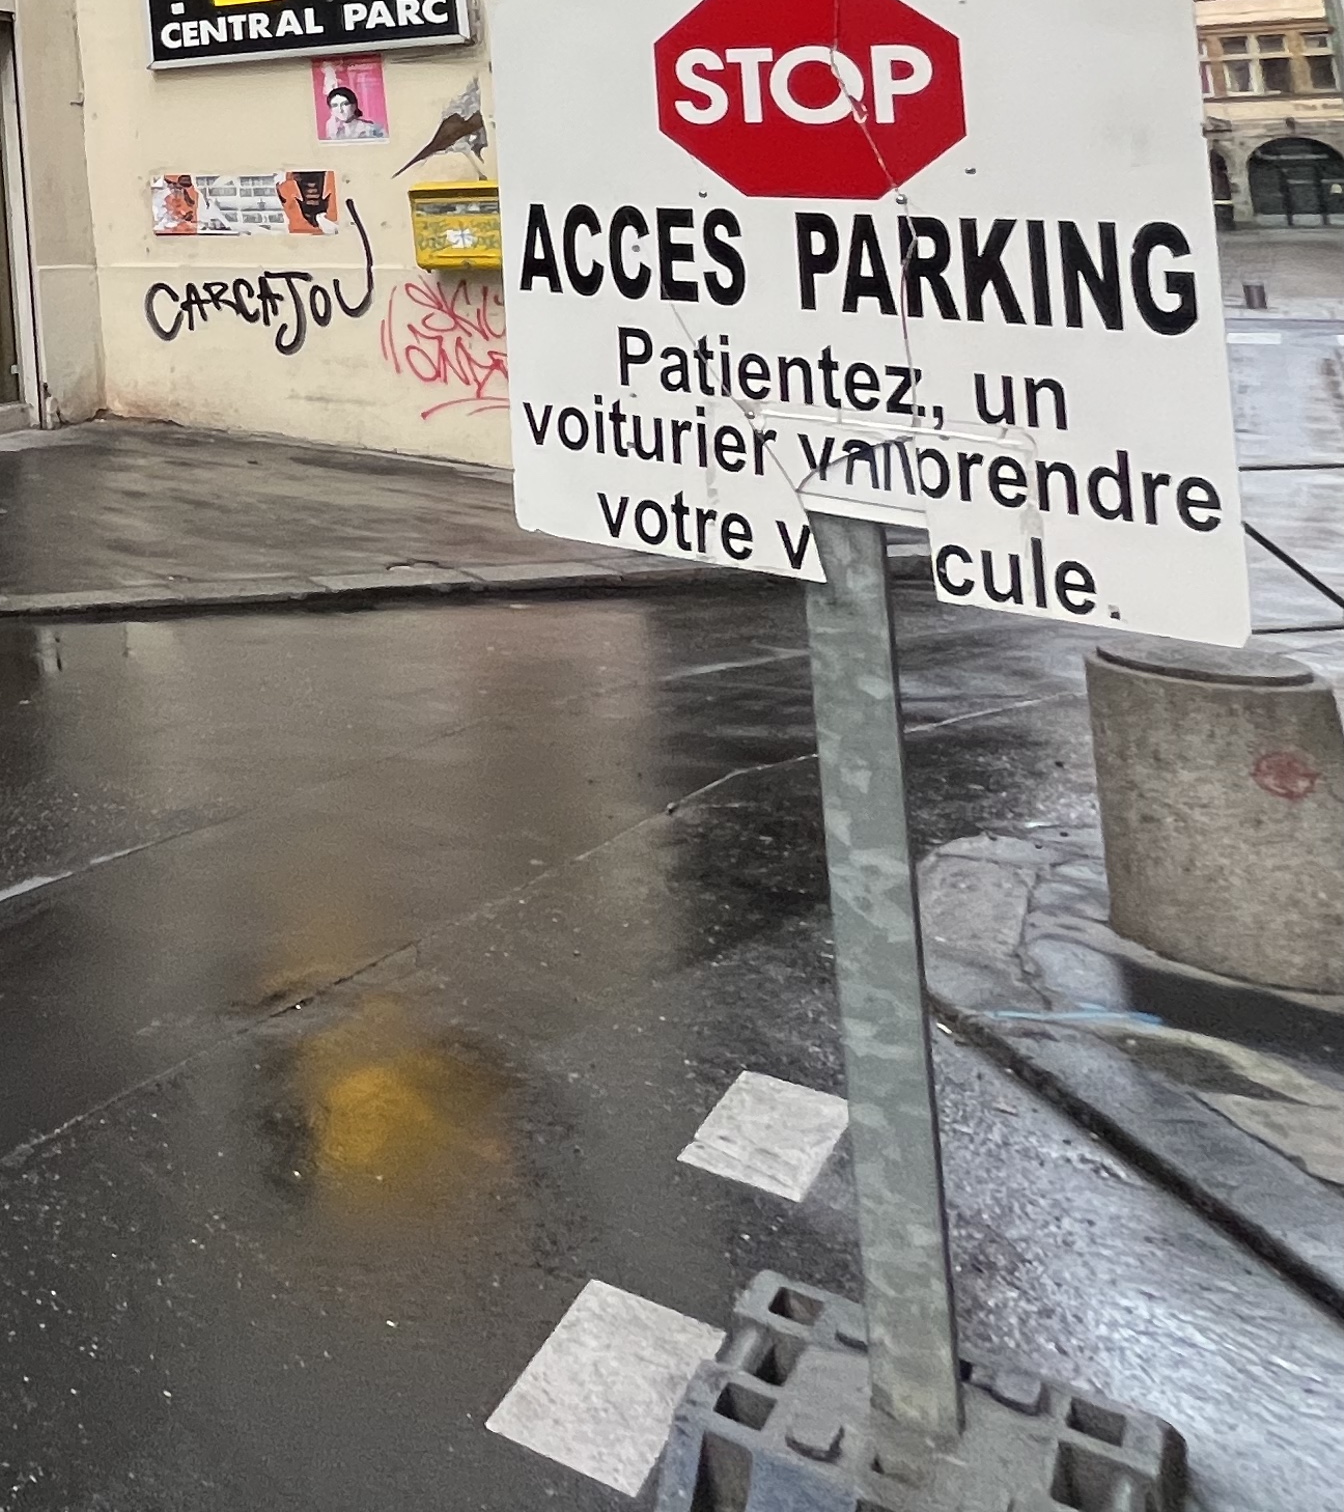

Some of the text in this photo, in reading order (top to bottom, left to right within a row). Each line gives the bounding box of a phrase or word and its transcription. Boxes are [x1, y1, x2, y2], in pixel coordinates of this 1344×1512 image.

[160, 7, 324, 49] CENTRAL
[673, 44, 934, 124] STOP
[144, 198, 374, 356] CARCAJOU
[519, 203, 1199, 336] ACCES PARKING
[618, 327, 1068, 431] Patientez, un
[522, 394, 777, 478] voiturier
[597, 491, 754, 562] votre
